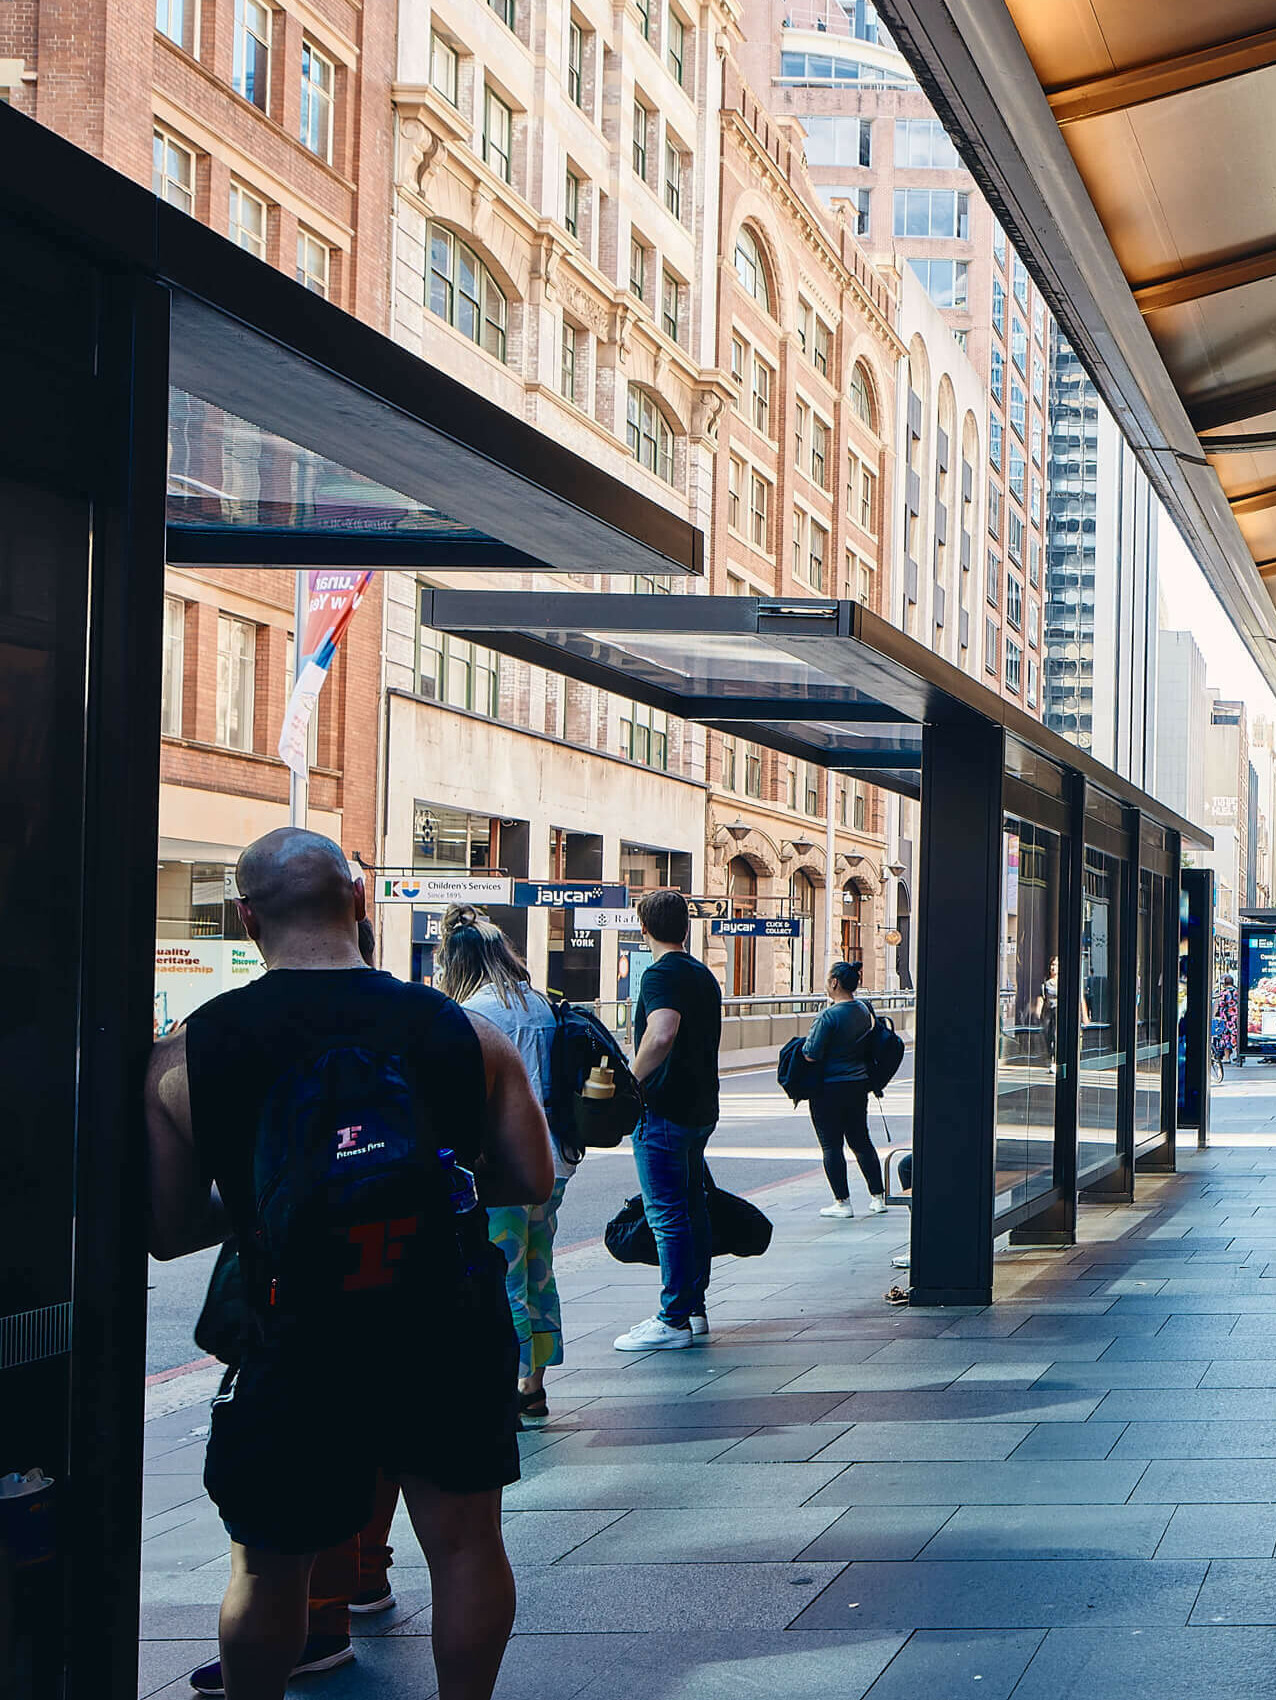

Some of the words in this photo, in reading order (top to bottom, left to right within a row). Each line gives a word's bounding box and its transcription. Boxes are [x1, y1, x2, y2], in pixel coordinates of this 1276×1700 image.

[428, 882, 467, 890] Children's
[468, 882, 502, 890] Services
[535, 886, 593, 906] jaycar
[718, 920, 756, 933] jaycar
[574, 930, 590, 938] 127
[571, 939, 594, 947] YORK
[157, 948, 190, 956] uality
[232, 949, 246, 957] Play
[156, 957, 200, 965] eritage
